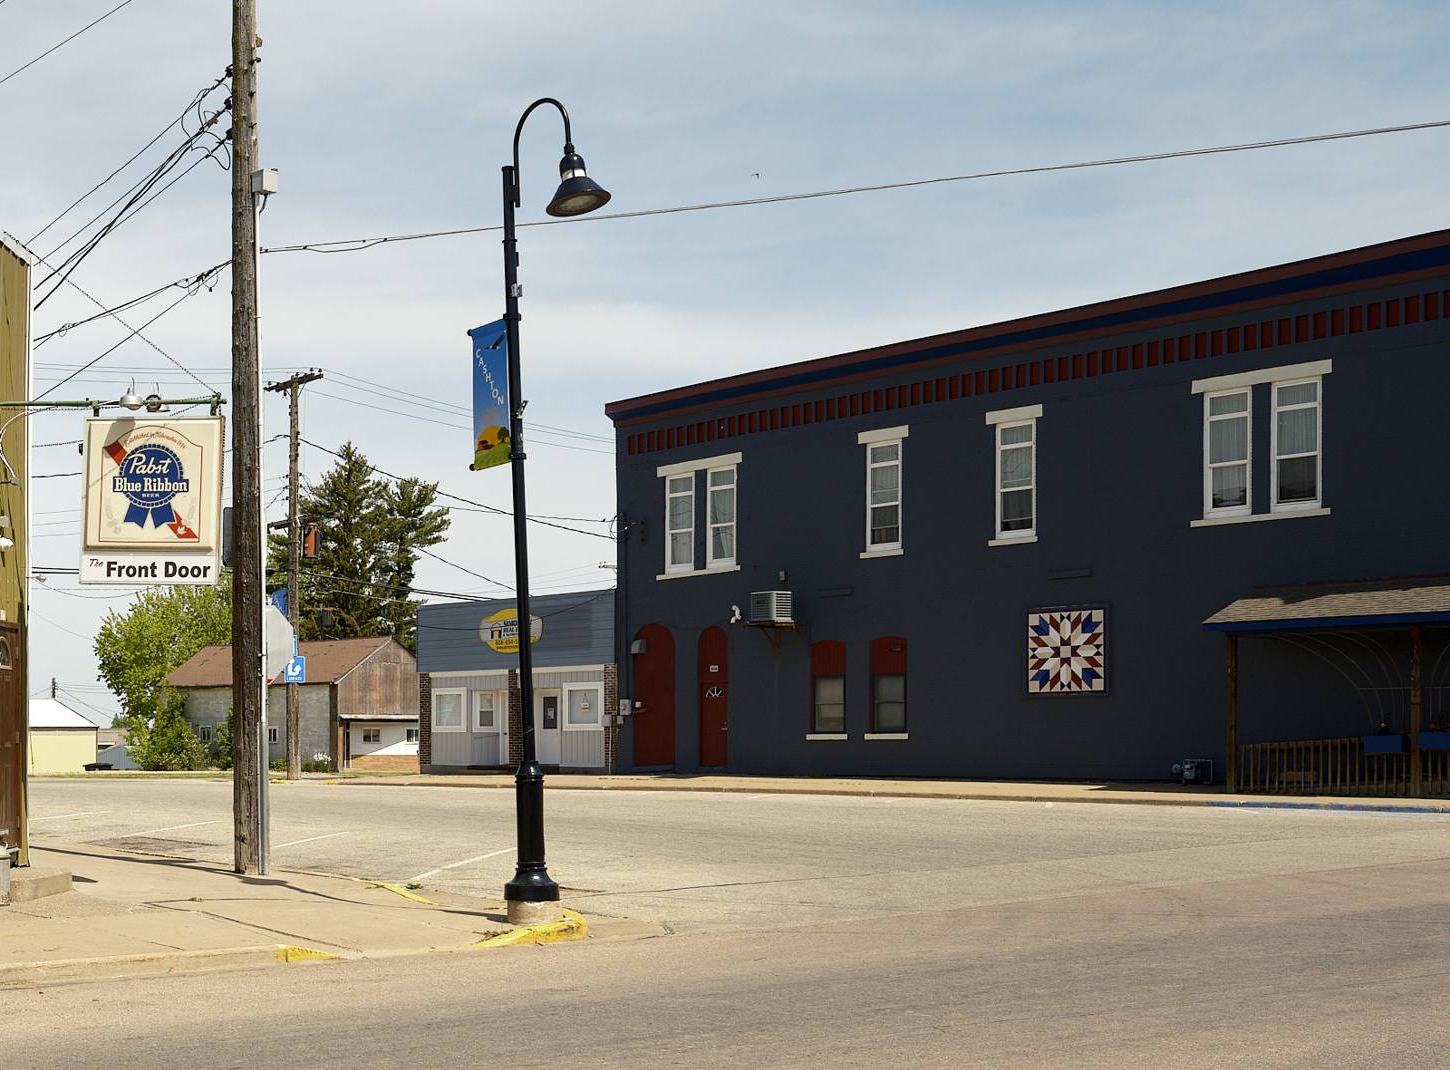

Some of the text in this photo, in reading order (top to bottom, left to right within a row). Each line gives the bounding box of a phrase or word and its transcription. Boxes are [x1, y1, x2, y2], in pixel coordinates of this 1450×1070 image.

[475, 348, 505, 405] CASHTON
[127, 453, 172, 474] Pabst
[113, 476, 188, 492] Blue Ribbon
[89, 558, 211, 578] The Front Door
